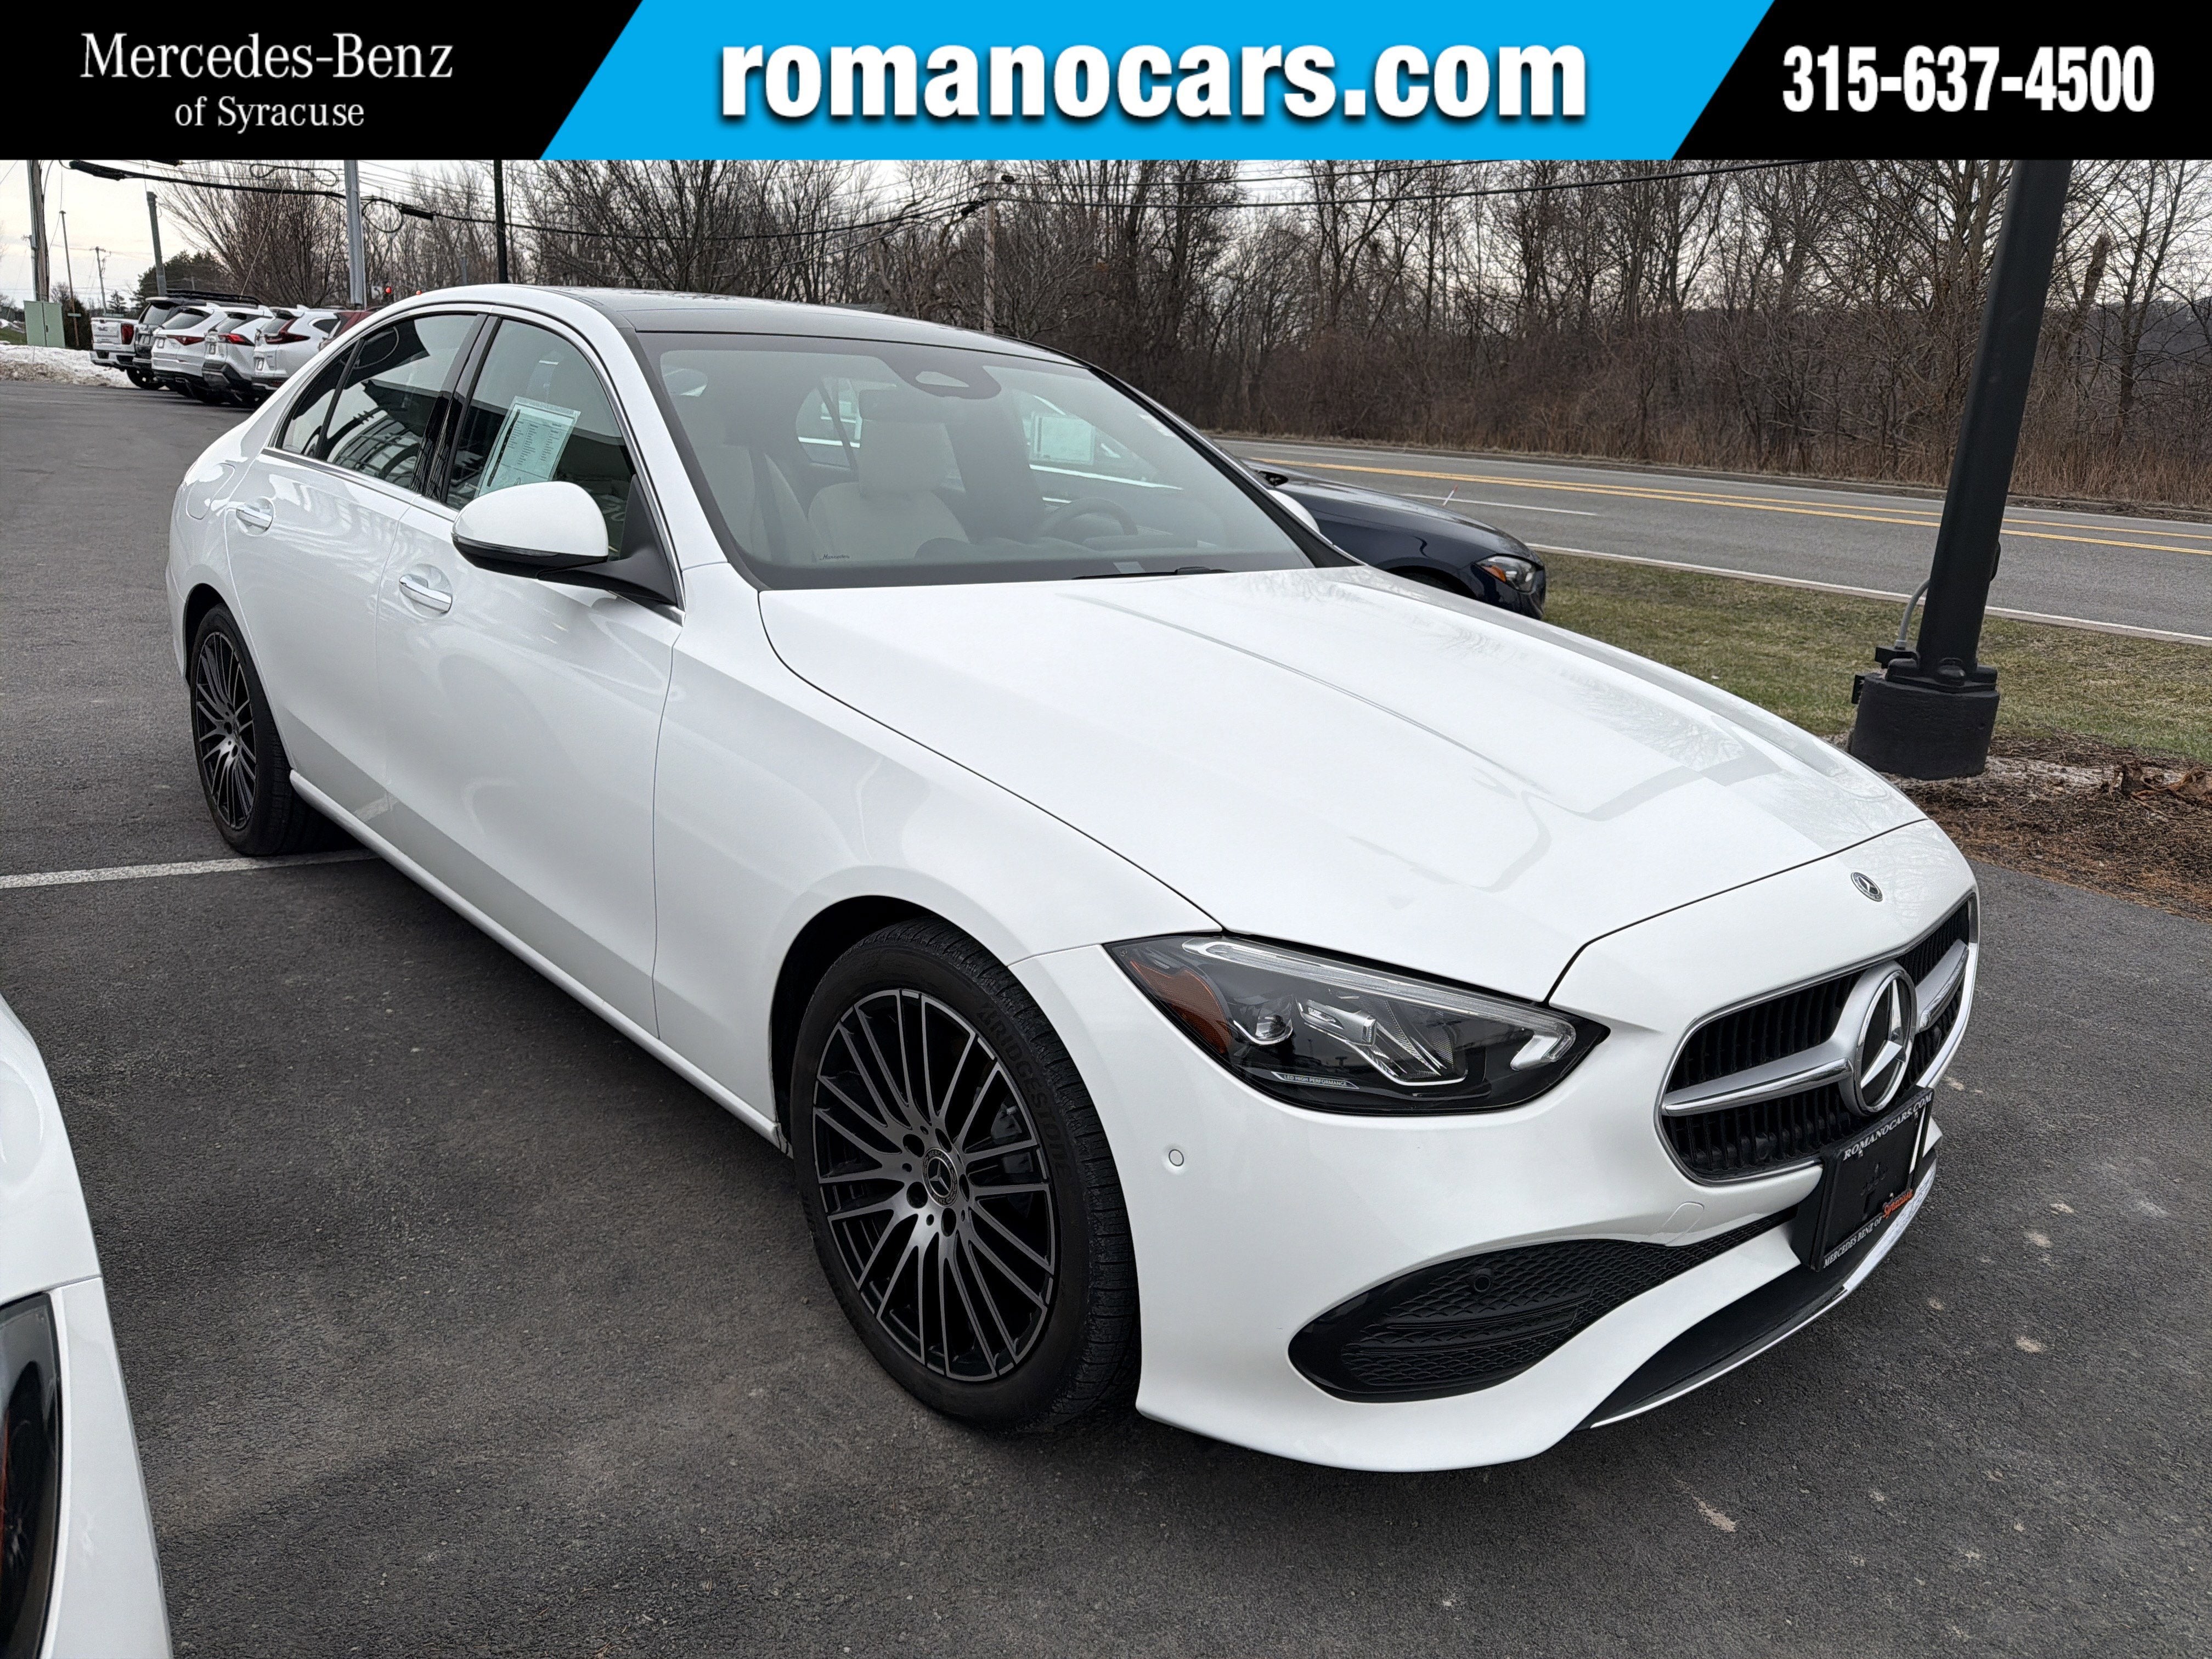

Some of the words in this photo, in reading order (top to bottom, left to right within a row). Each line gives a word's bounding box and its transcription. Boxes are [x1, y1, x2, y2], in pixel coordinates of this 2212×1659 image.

[1309, 1078, 1347, 1086] PERFORMANCE
[1842, 1092, 1933, 1161] ROMANOCARS.COM
[1823, 1235, 1858, 1269] MERCEDES
[1857, 1222, 1875, 1242] BENZ
[1874, 1216, 1883, 1227] OF
